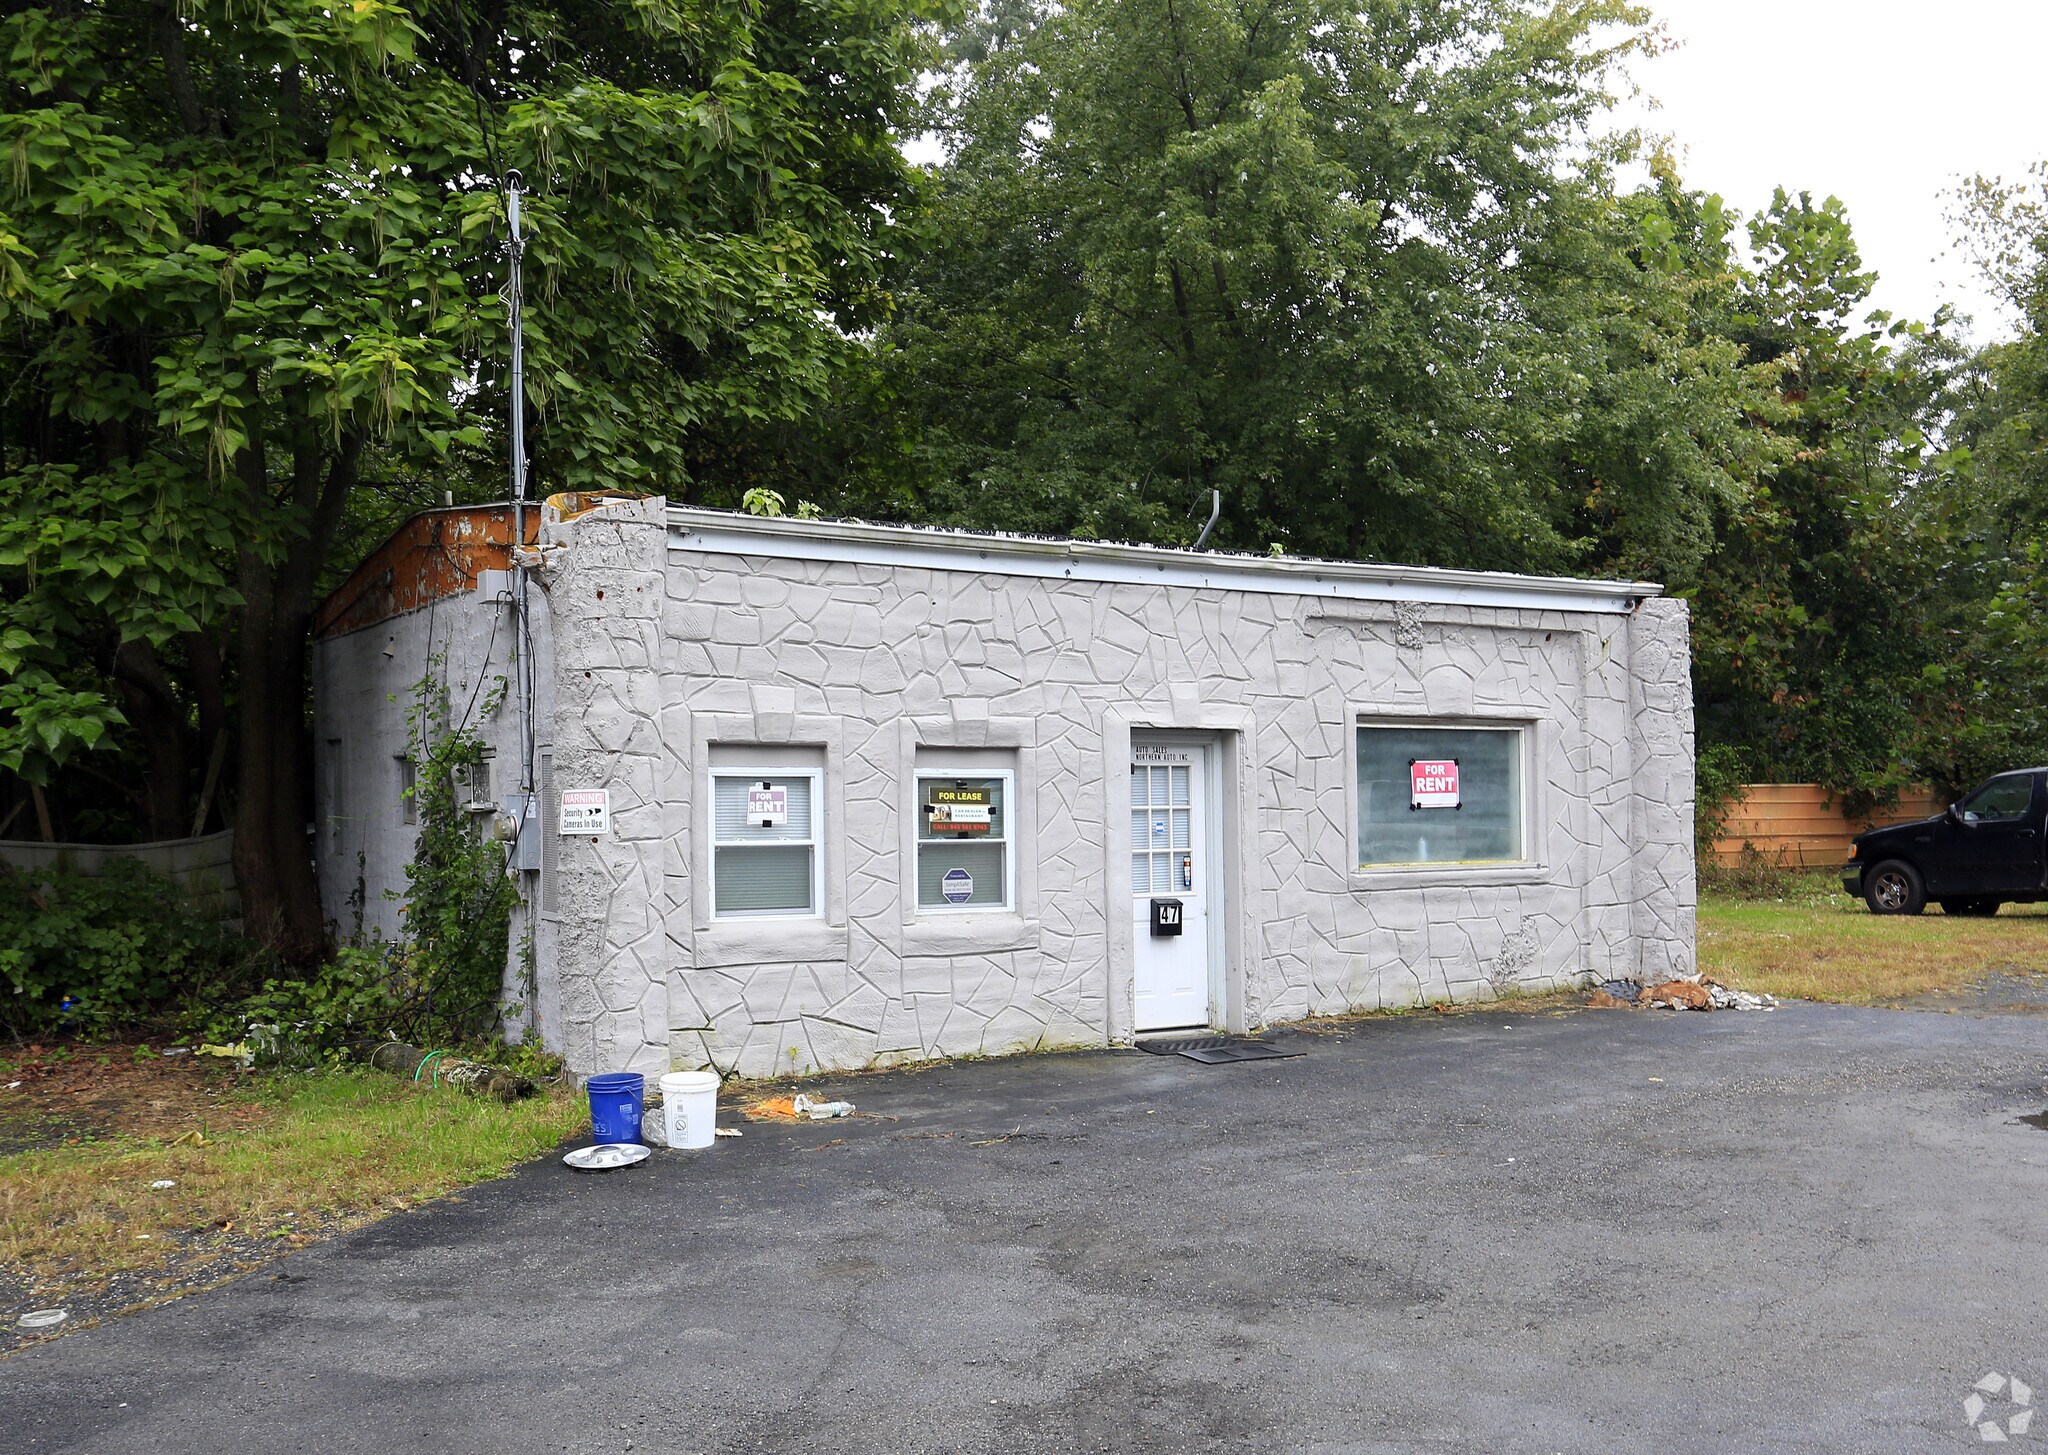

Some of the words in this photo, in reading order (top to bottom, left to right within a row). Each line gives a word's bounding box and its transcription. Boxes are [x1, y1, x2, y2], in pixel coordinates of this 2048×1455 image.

[1163, 753, 1176, 761] AUTO
[1425, 764, 1445, 775] FOR
[1416, 777, 1455, 792] RENT
[564, 793, 604, 804] WARNING
[756, 792, 772, 800] FOR
[938, 792, 955, 801] FOR
[957, 792, 982, 801] LEASE
[750, 801, 783, 812] RENT
[563, 808, 583, 818] Security
[563, 819, 583, 828] Cameras
[584, 819, 590, 828] In
[591, 820, 602, 828] Use
[1161, 905, 1178, 923] 47
